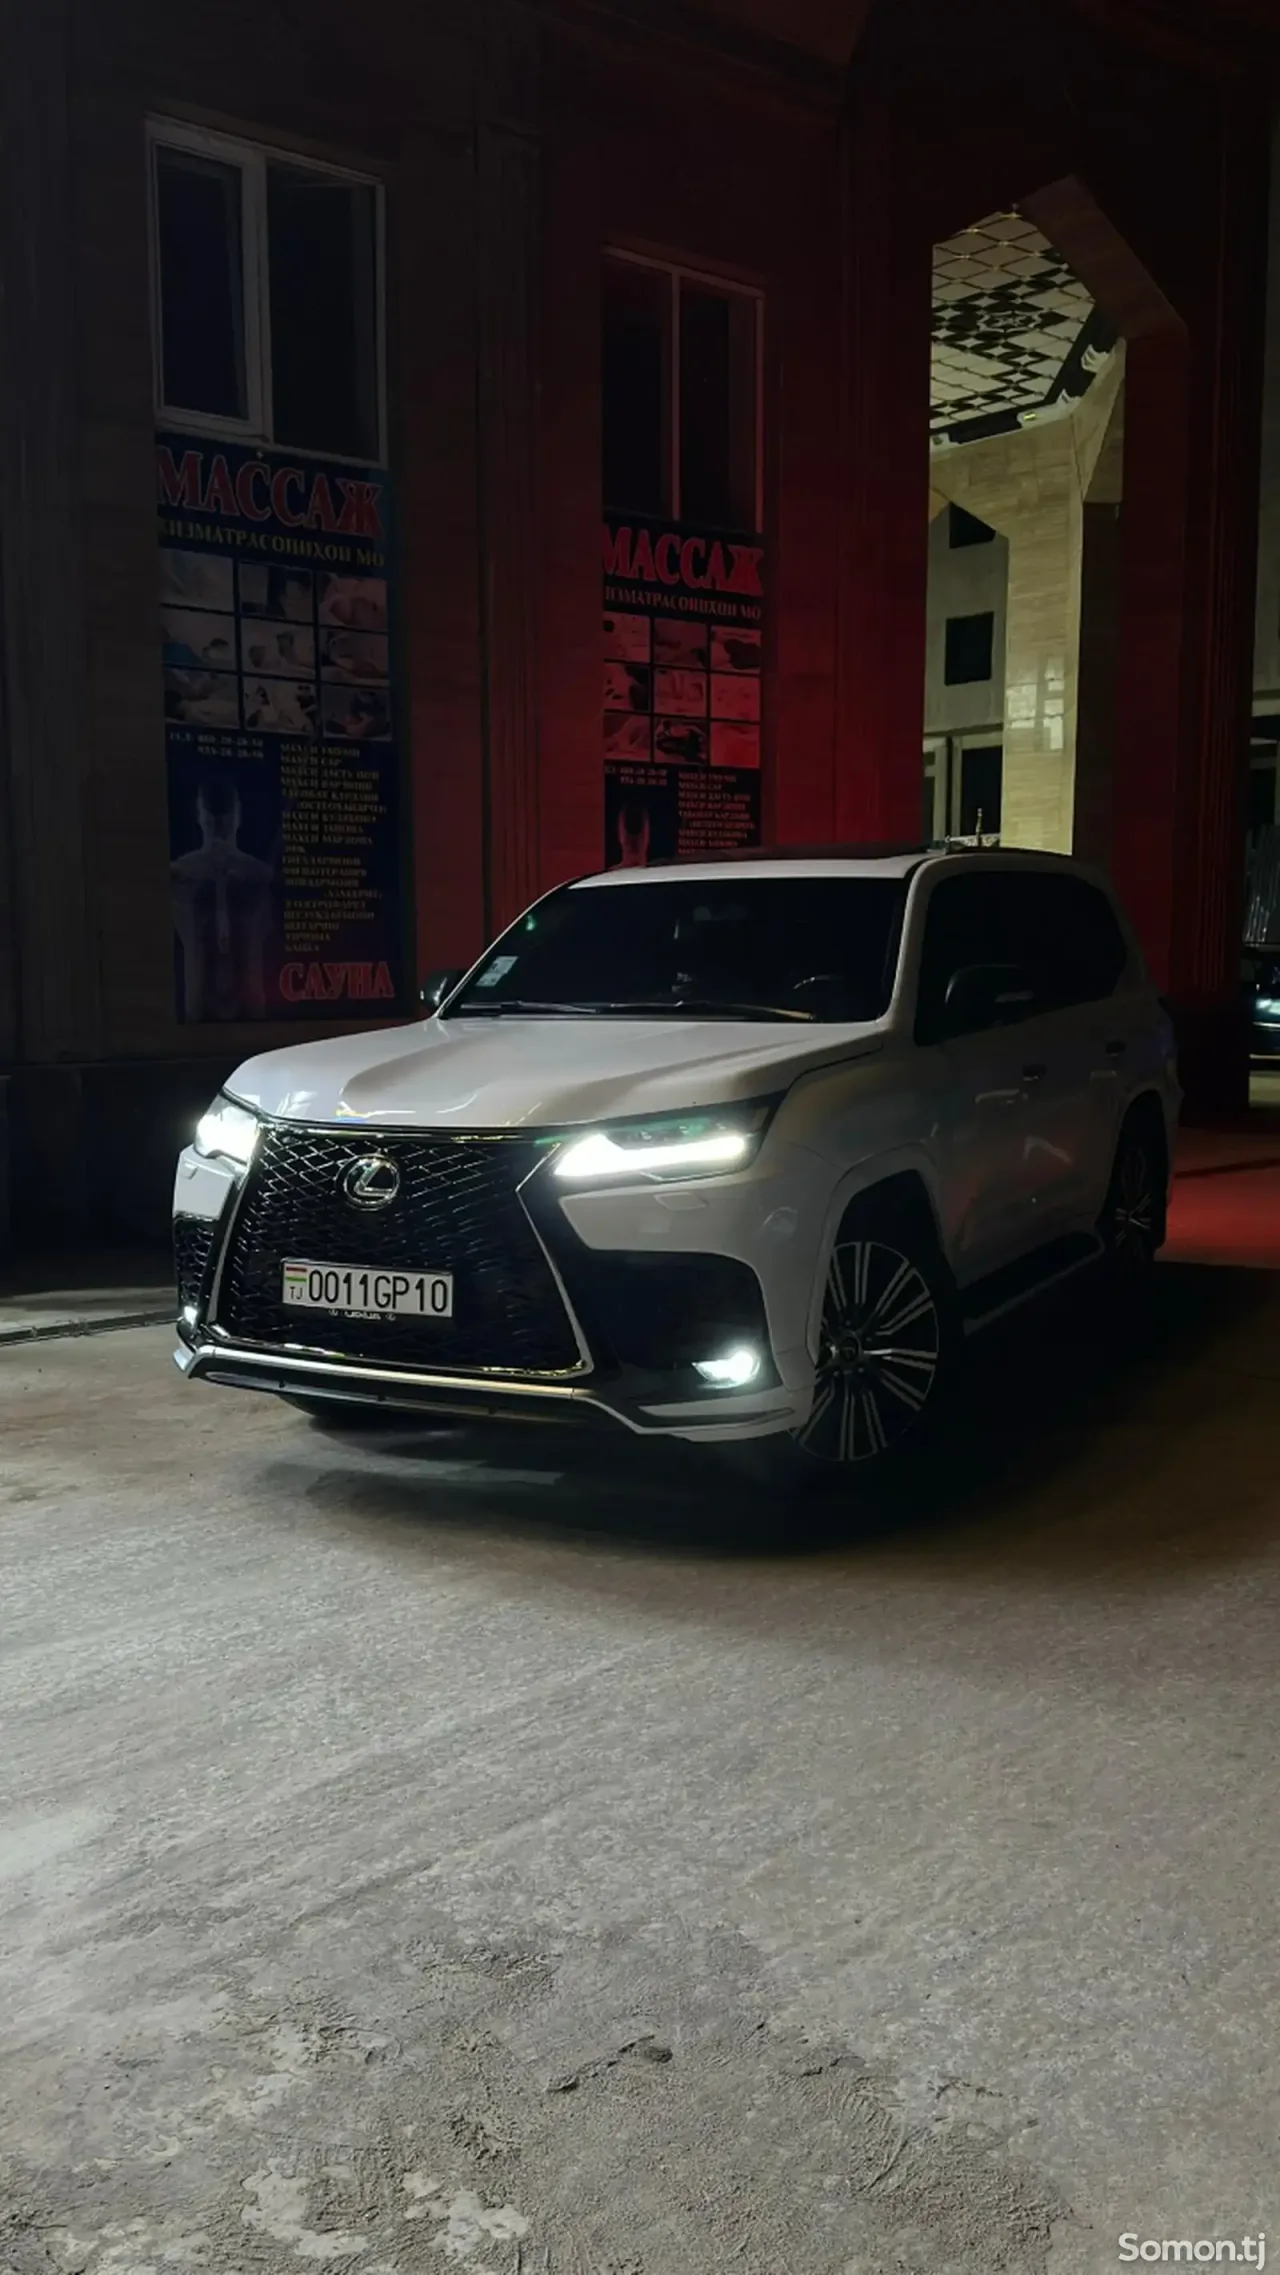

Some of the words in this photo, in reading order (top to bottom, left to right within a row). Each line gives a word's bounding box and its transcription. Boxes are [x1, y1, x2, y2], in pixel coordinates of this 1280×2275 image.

[155, 444, 383, 539] МАССАЖ
[603, 523, 764, 597] МАССАЖ
[280, 961, 396, 1002] САУНА
[290, 1286, 303, 1300] TJ
[309, 1270, 448, 1312] 0011GP10
